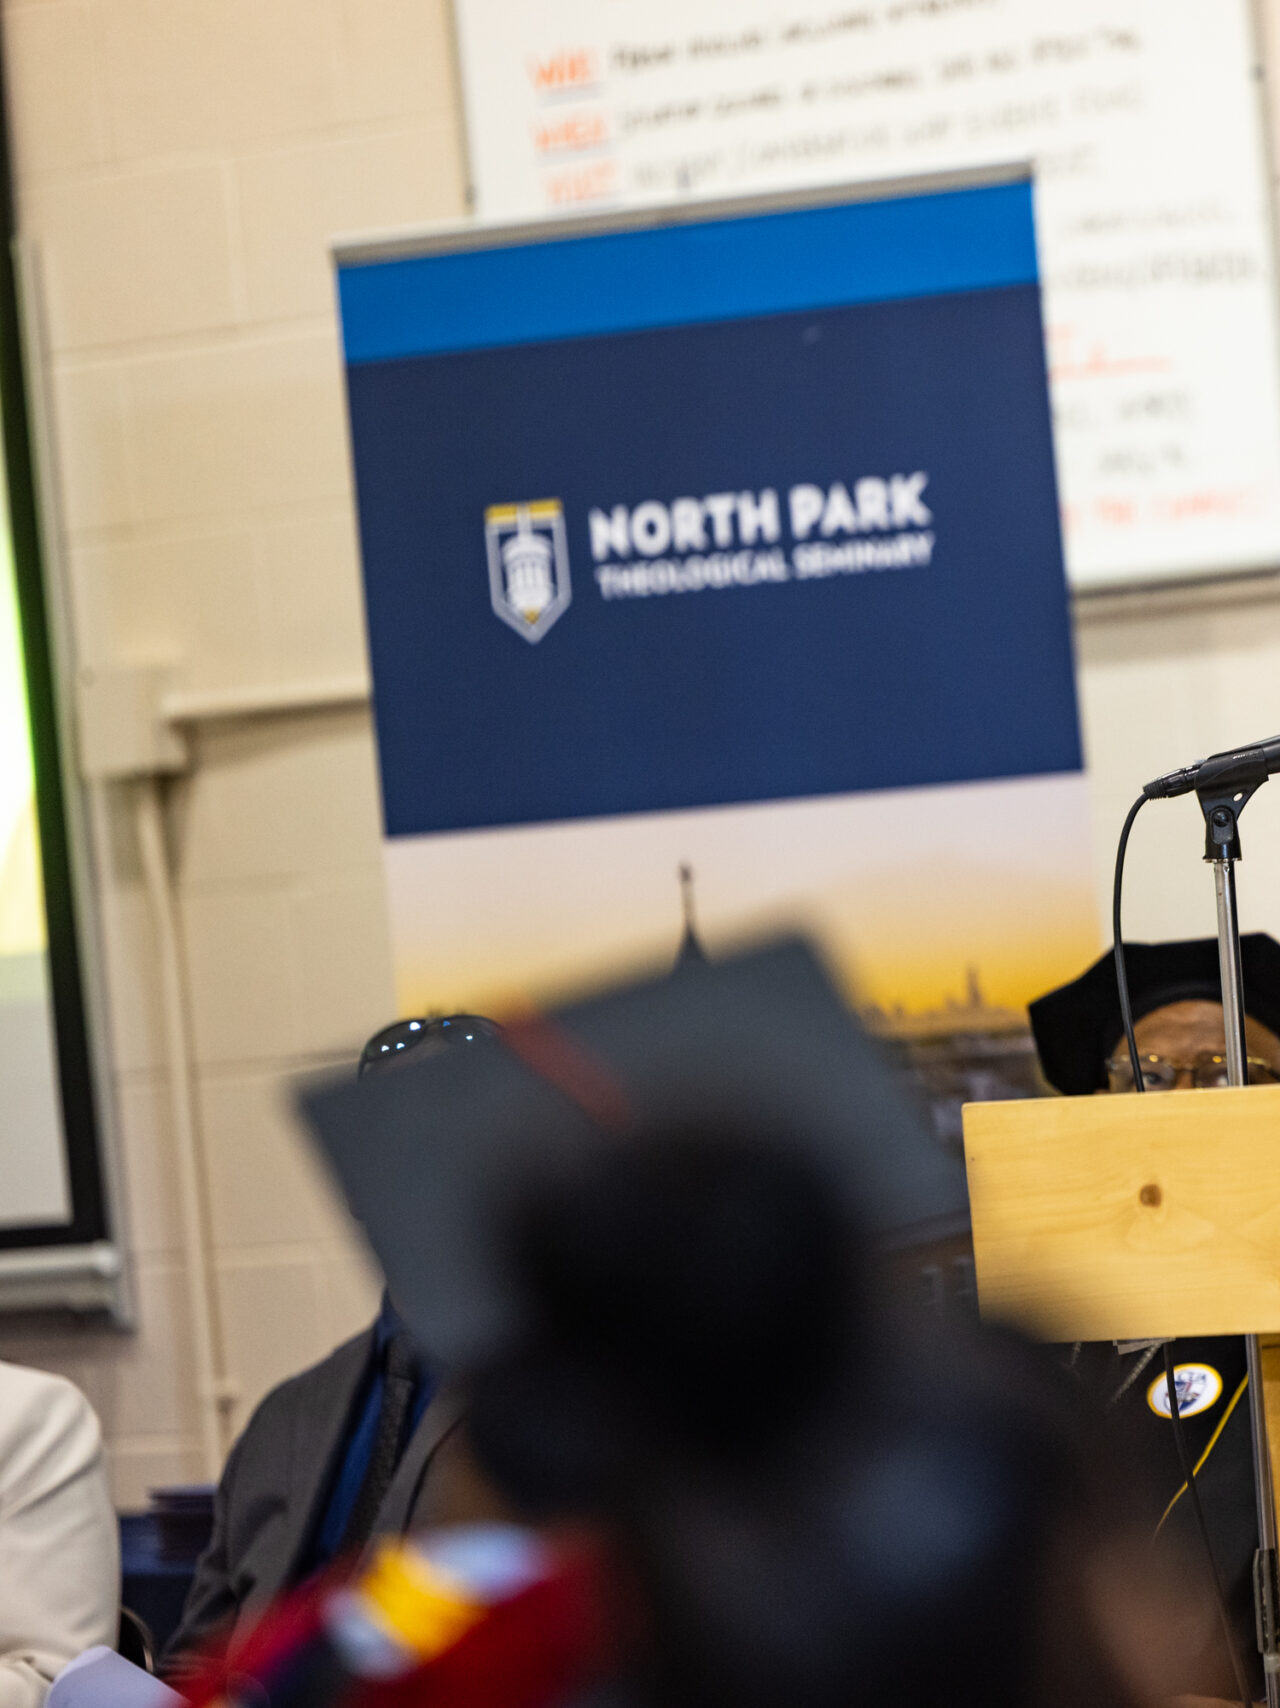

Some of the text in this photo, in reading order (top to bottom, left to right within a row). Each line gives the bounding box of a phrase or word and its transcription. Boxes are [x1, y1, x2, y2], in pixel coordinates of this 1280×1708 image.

[589, 470, 932, 560] NORTH PARK
[595, 531, 933, 599] THEOLOGICAL SEMINARY
